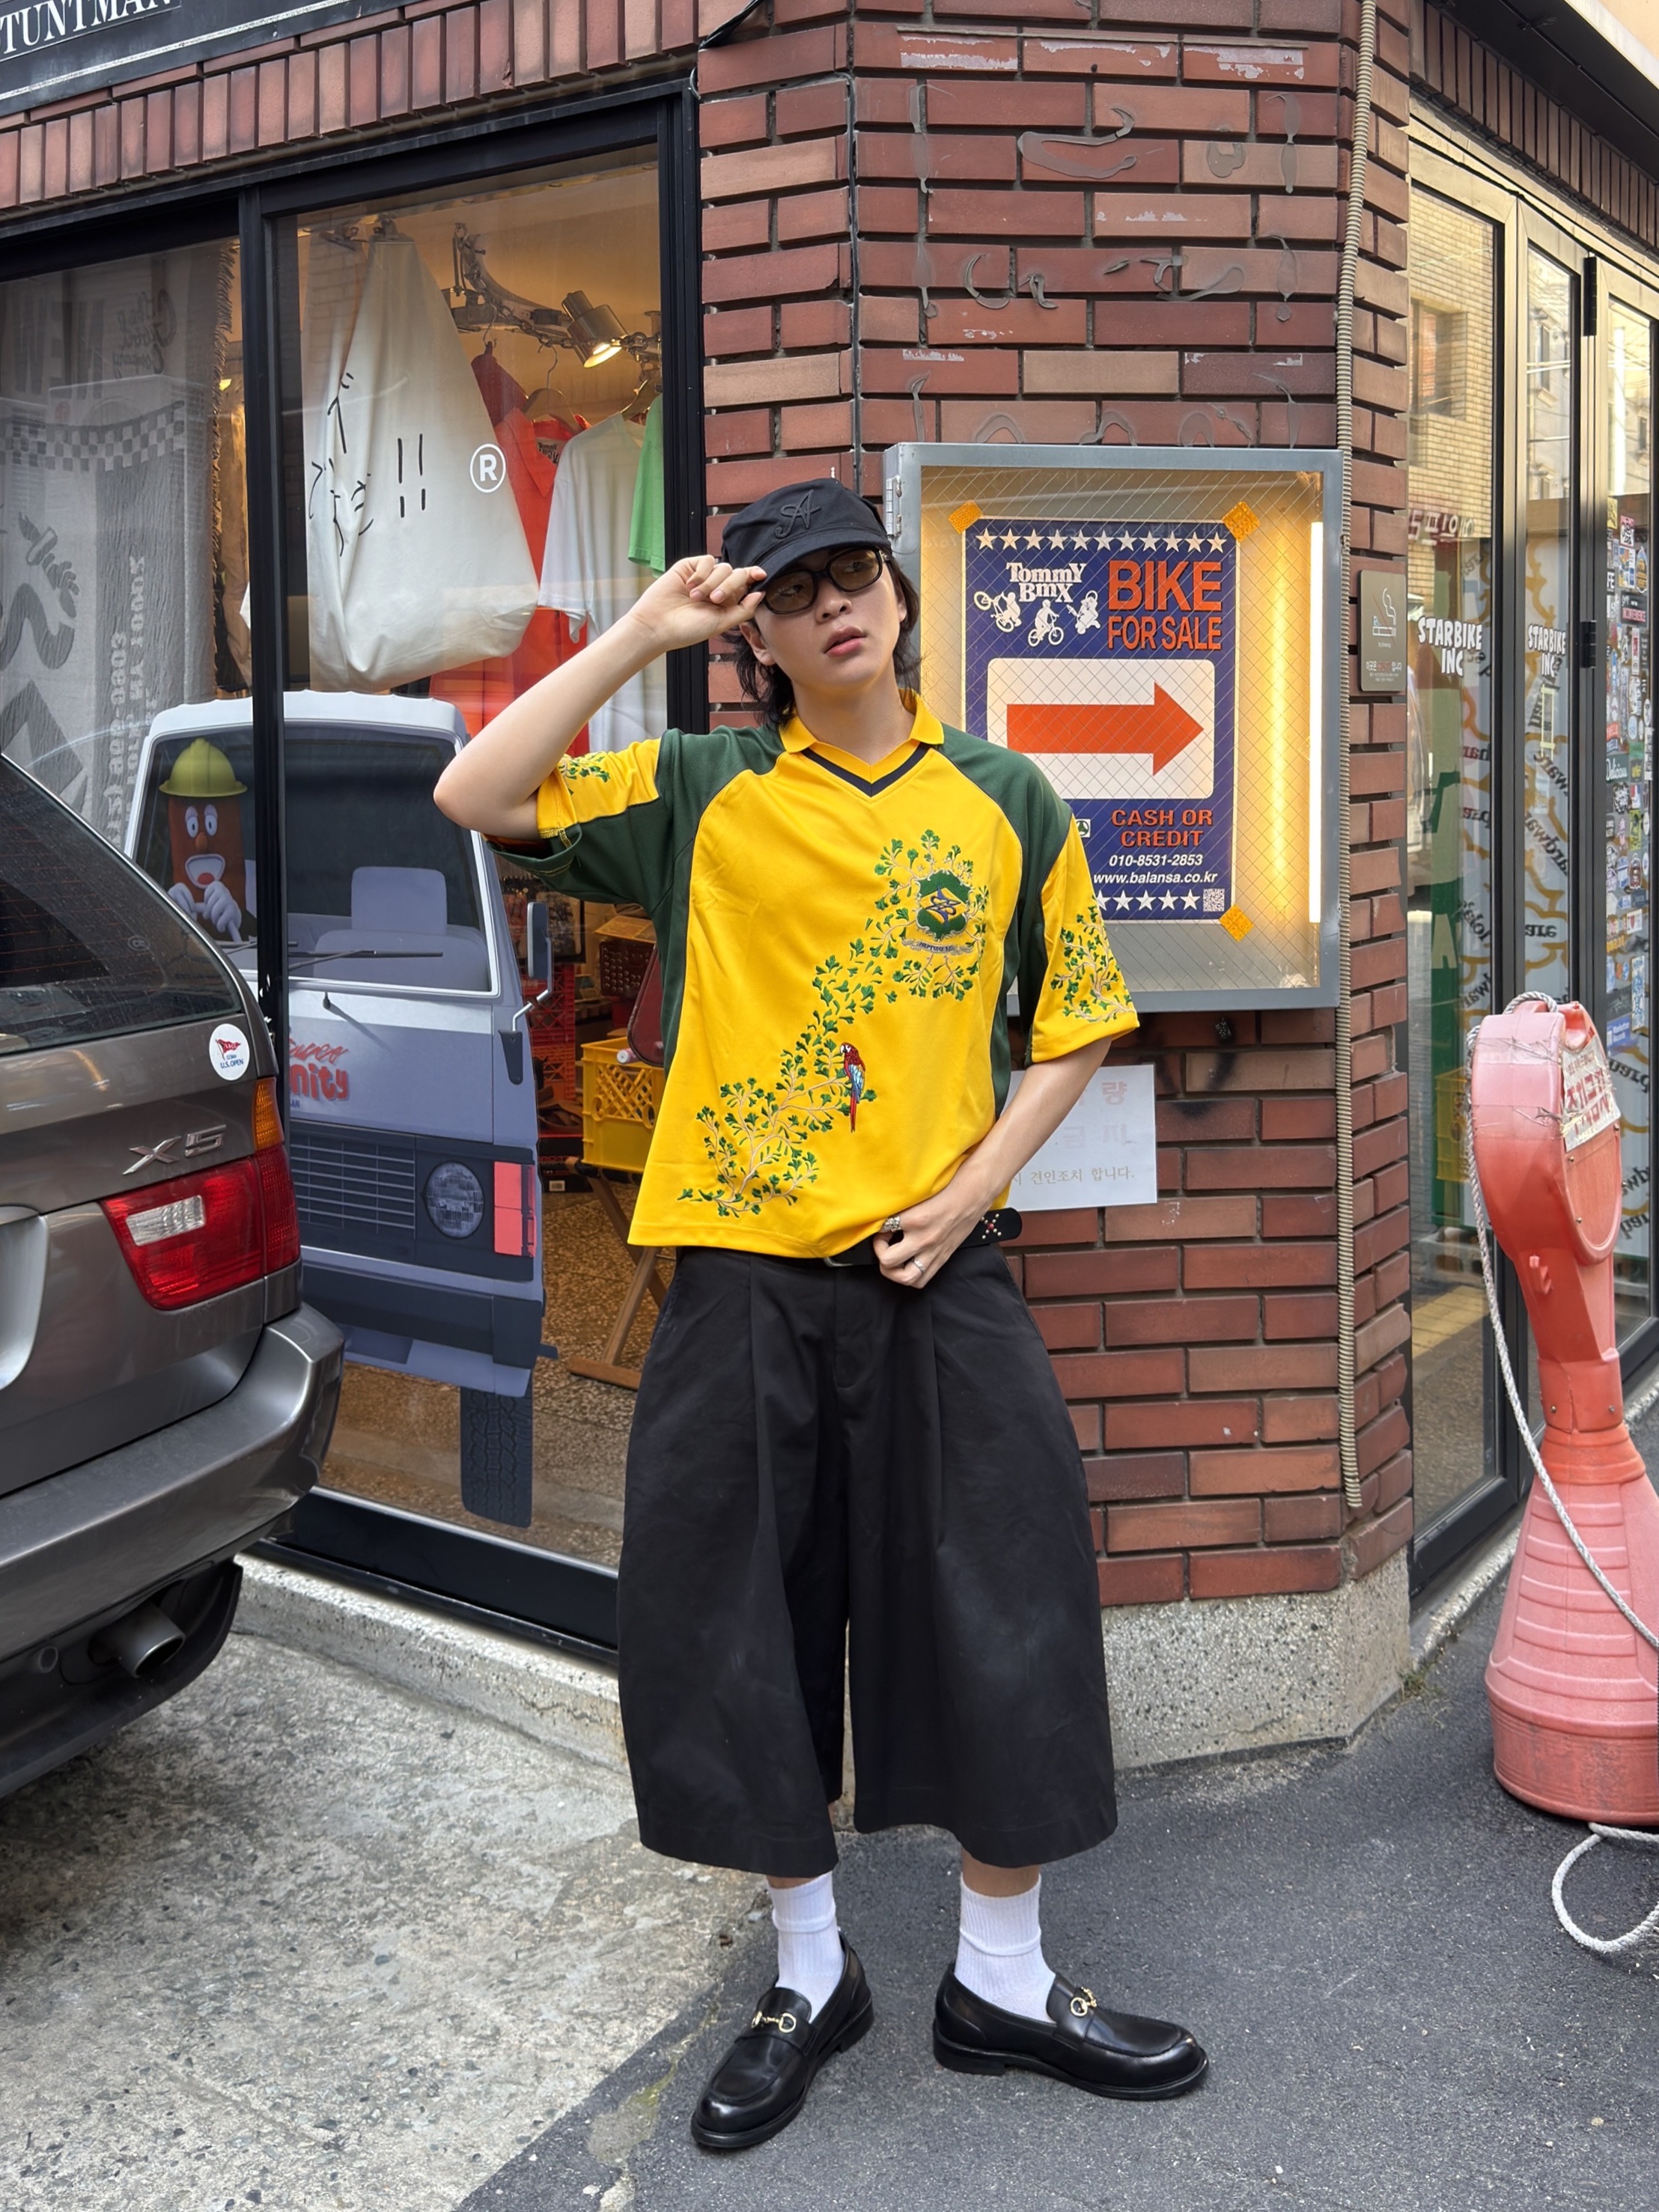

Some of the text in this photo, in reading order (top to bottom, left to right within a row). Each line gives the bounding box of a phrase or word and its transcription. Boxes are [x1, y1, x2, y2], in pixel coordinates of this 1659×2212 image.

[1108, 560, 1223, 612] BIKE
[1108, 615, 1223, 651] FOR SALE
[1418, 617, 1482, 650] STARBIKE
[1528, 624, 1566, 655] STARBIKE
[1441, 648, 1463, 676] INC
[1541, 653, 1555, 677] INC
[1111, 809, 1213, 826] CASH OR
[1120, 829, 1204, 847] CREDIT
[1109, 854, 1203, 867] 010-8531-2853
[1093, 871, 1218, 884] www.balansa.co.kr
[230, 1058, 244, 1067] OPEN
[123, 1124, 226, 1174] X5
[1030, 1168, 1083, 1185] 견인조치
[1091, 1166, 1135, 1182] 합니다.
